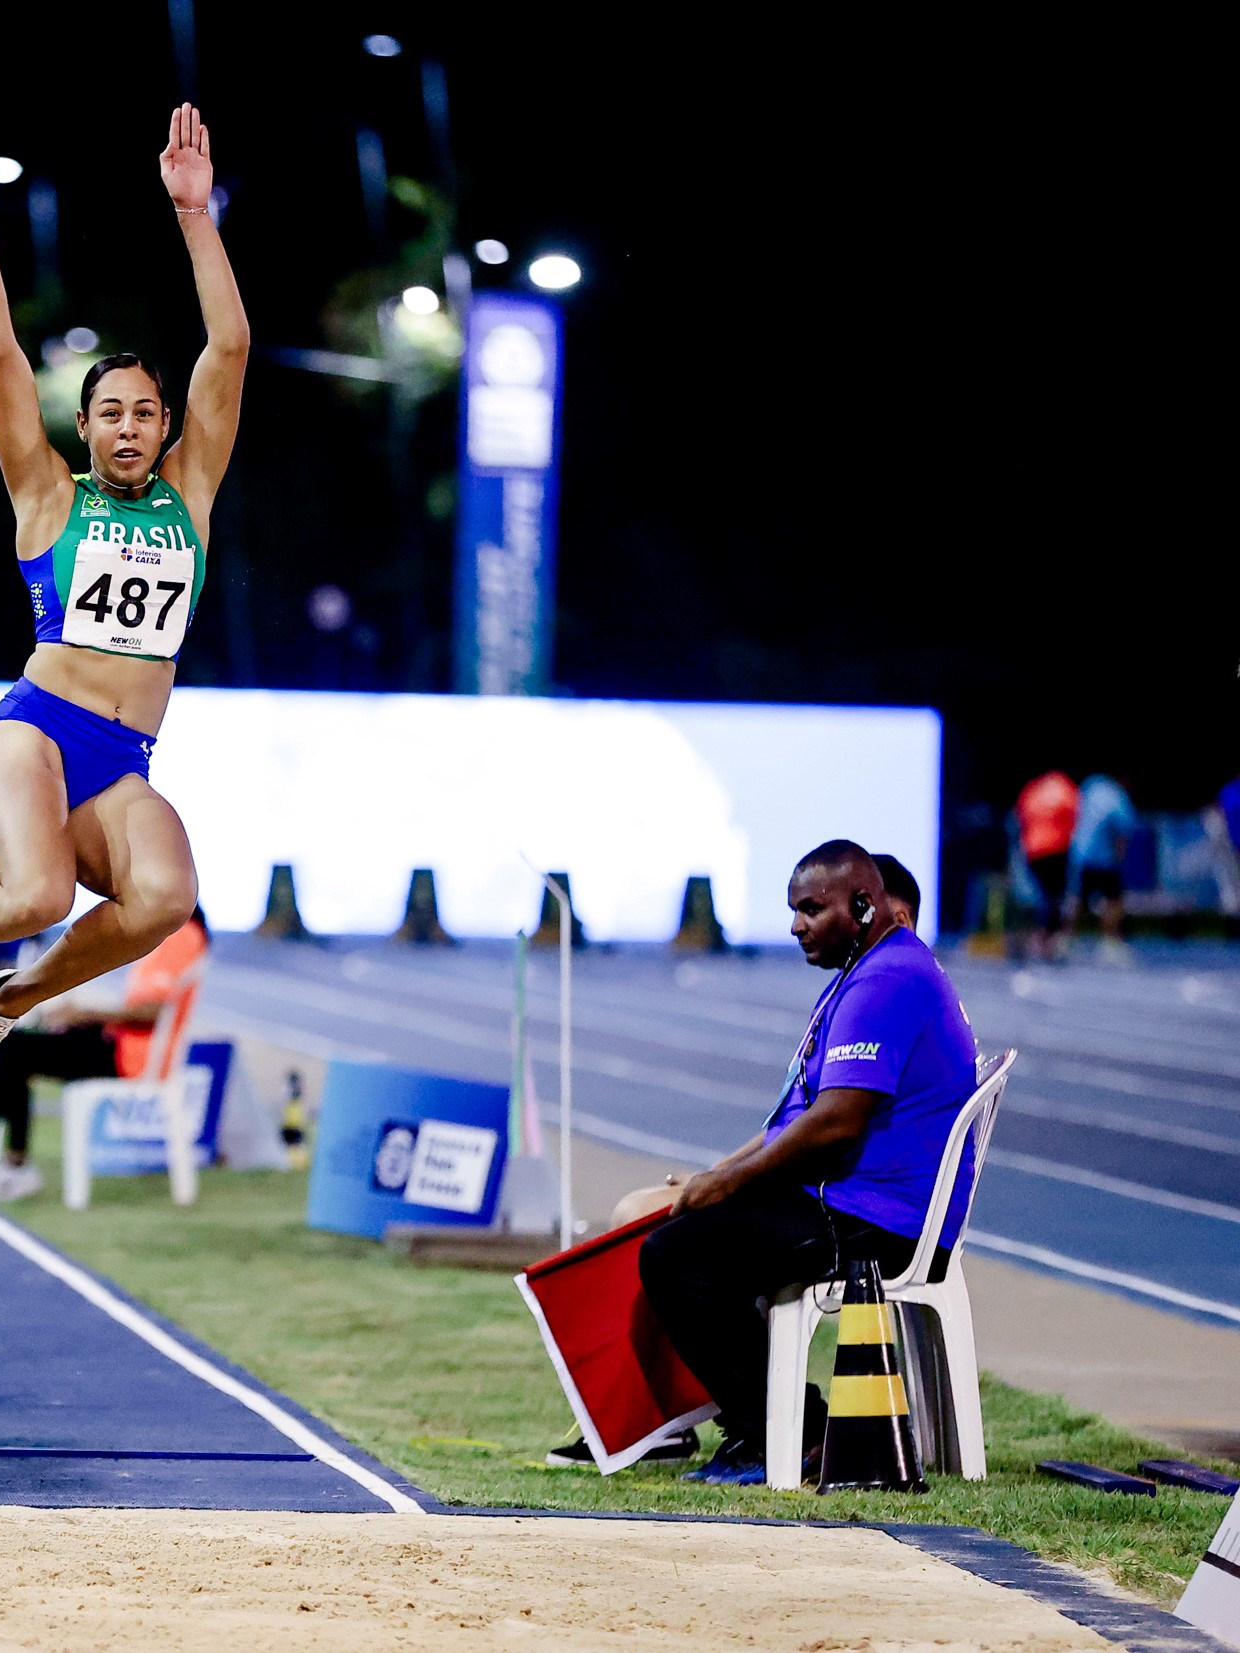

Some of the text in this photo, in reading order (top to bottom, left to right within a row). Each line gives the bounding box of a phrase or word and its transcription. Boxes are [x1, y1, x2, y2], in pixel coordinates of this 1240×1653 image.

[135, 549, 161, 558] loterias
[135, 556, 161, 565] CAIXA
[75, 573, 186, 631] 487
